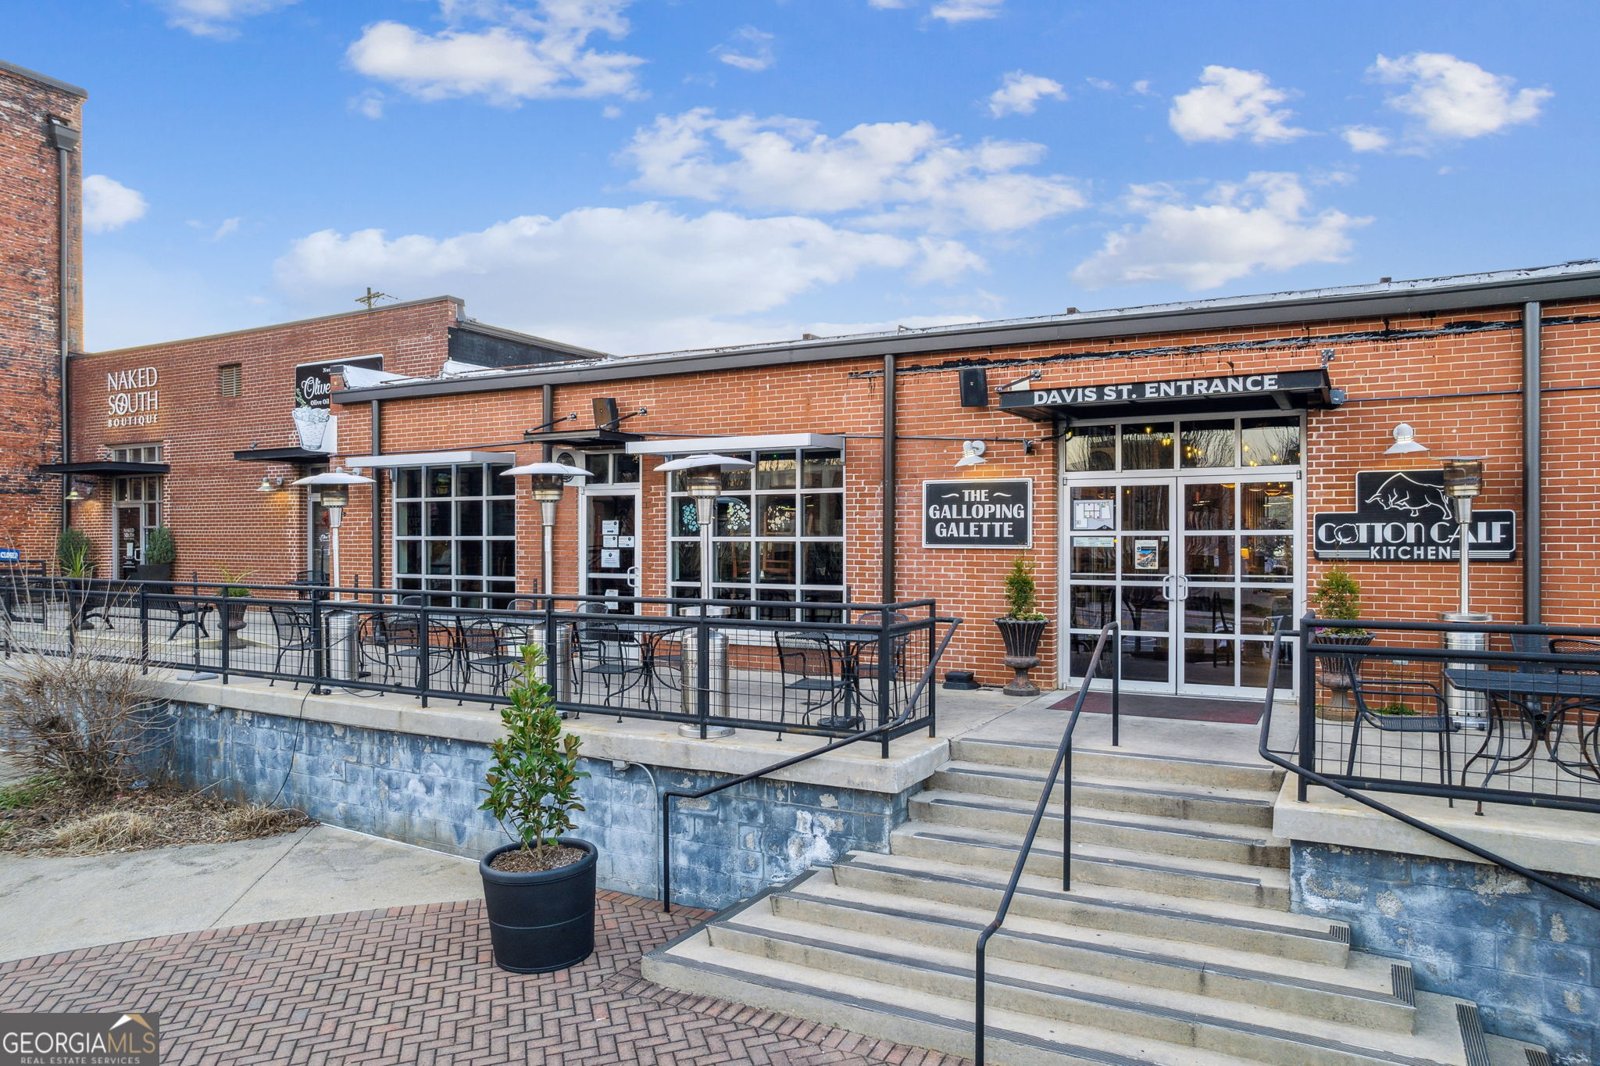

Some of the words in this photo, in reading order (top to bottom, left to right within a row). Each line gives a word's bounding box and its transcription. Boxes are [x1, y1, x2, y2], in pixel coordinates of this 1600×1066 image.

[108, 367, 158, 391] NAKED
[301, 376, 331, 399] Olive
[1033, 387, 1097, 405] DAVIS
[1103, 384, 1136, 400] ST.
[1145, 375, 1278, 397] ENTRANCE
[108, 391, 158, 415] SOUTH
[108, 414, 158, 428] BOUTIQUE
[962, 489, 989, 502] THE
[928, 504, 1025, 519] GALLOPING
[935, 522, 1014, 538] GALETTE
[1370, 546, 1450, 560] KITCHEN
